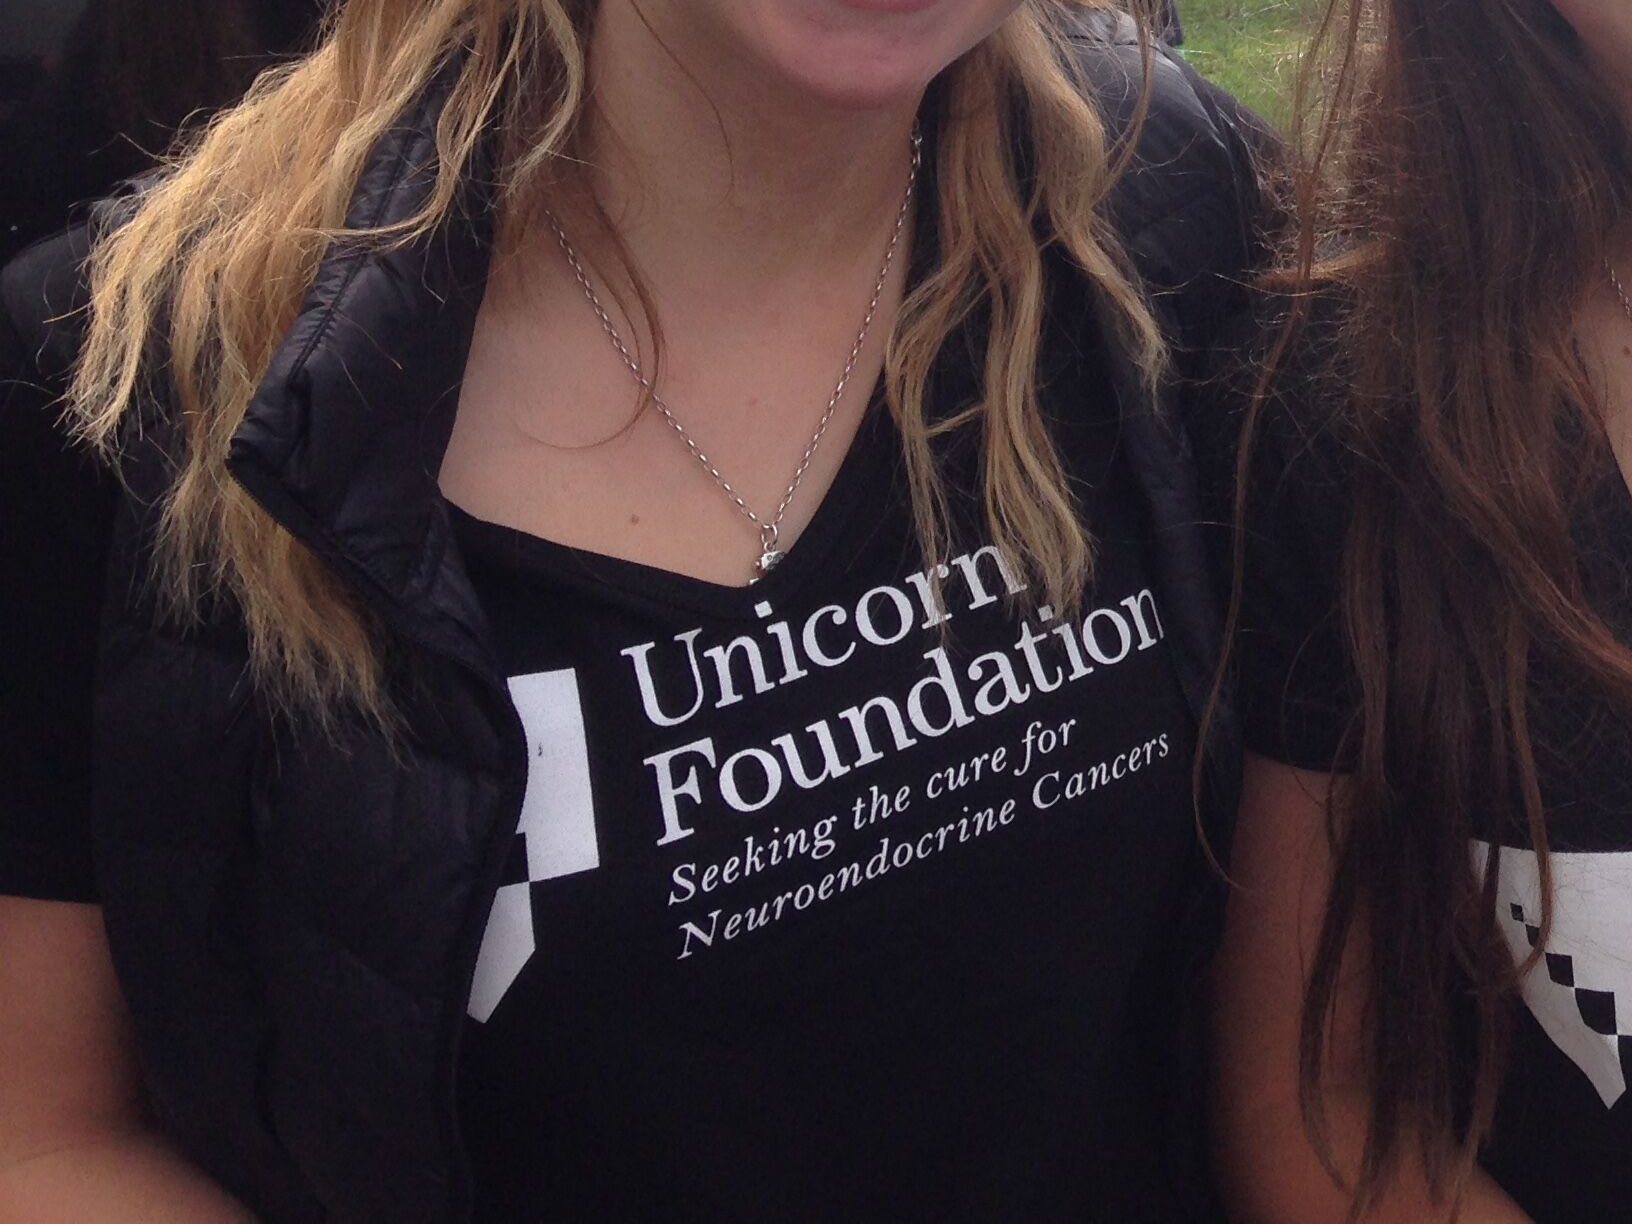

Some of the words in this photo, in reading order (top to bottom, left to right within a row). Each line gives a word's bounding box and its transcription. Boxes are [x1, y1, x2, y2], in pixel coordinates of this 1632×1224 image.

[621, 545, 1028, 728] Unicorn
[643, 588, 1165, 846] Foundation
[668, 814, 838, 906] Seeking
[852, 786, 911, 831] the
[926, 752, 1007, 802] cure
[1013, 719, 1077, 777] for
[676, 796, 1017, 960] Neuroendocrine
[1031, 729, 1170, 810] Cancers
